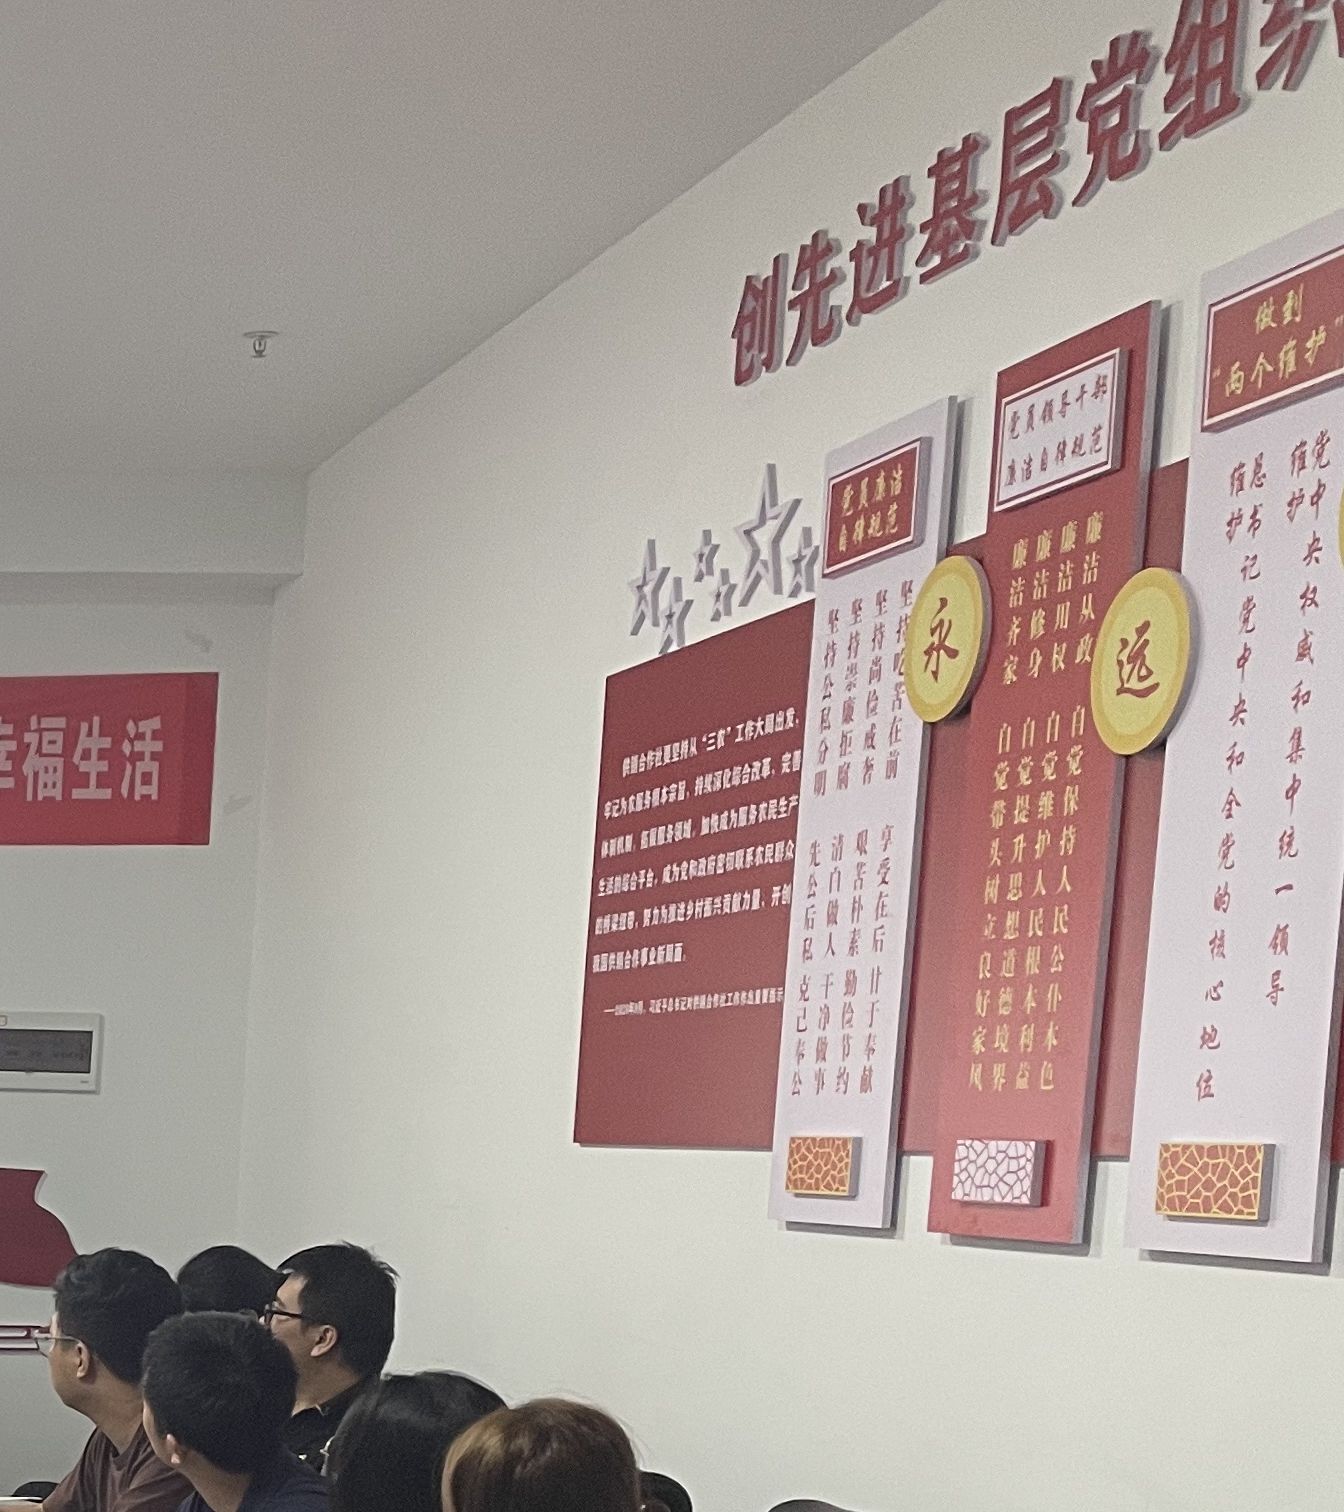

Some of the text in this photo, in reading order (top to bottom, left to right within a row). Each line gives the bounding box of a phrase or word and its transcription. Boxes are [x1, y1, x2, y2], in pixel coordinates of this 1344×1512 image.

[1255, 282, 1304, 335] 做到
[1008, 374, 1108, 440] 党员领导干部
[841, 463, 903, 517] 党员廉洁
[1004, 424, 1103, 486] 廉洁自律规范
[838, 502, 898, 553] 自律规范
[924, 597, 960, 683] 永
[1117, 621, 1160, 698] 远
[813, 608, 839, 799] 坚持公私分明
[992, 530, 1052, 1092] 廉洁修身 自觉提升思想道德境界
[1015, 520, 1078, 1091] 廉洁用权 自觉维护人民根本利益
[1039, 511, 1104, 1091] 廉洁从政 自觉保持人民公仆本色
[968, 722, 1012, 1092] 自觉带头树立良好家风
